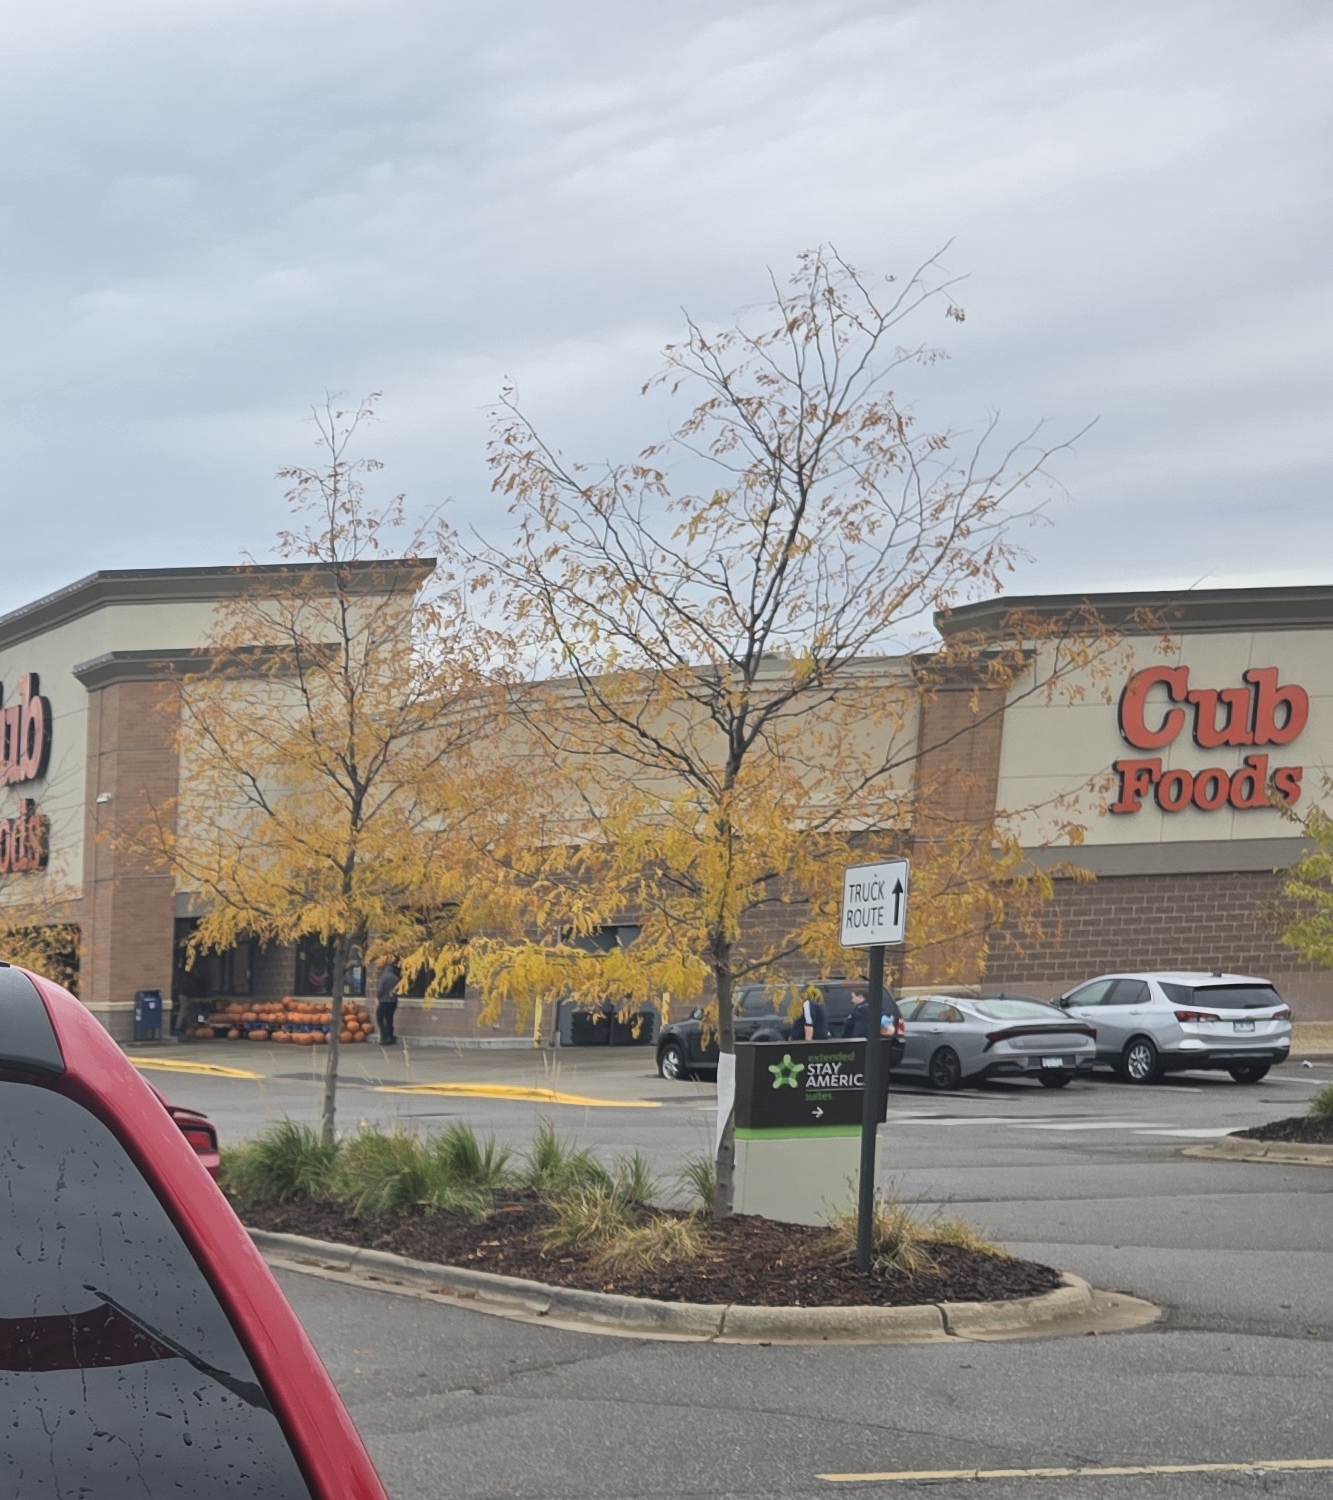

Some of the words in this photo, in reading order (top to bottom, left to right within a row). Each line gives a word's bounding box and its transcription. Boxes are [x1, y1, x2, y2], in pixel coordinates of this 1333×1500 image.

[1117, 665, 1309, 748] Cub
[1108, 753, 1304, 815] Foods
[848, 880, 885, 903] TRUCK
[846, 906, 884, 928] ROUTE
[807, 1051, 855, 1062] extended
[807, 1062, 842, 1076] STAY
[805, 1073, 865, 1087] AMERIC
[805, 1092, 832, 1101] suites
